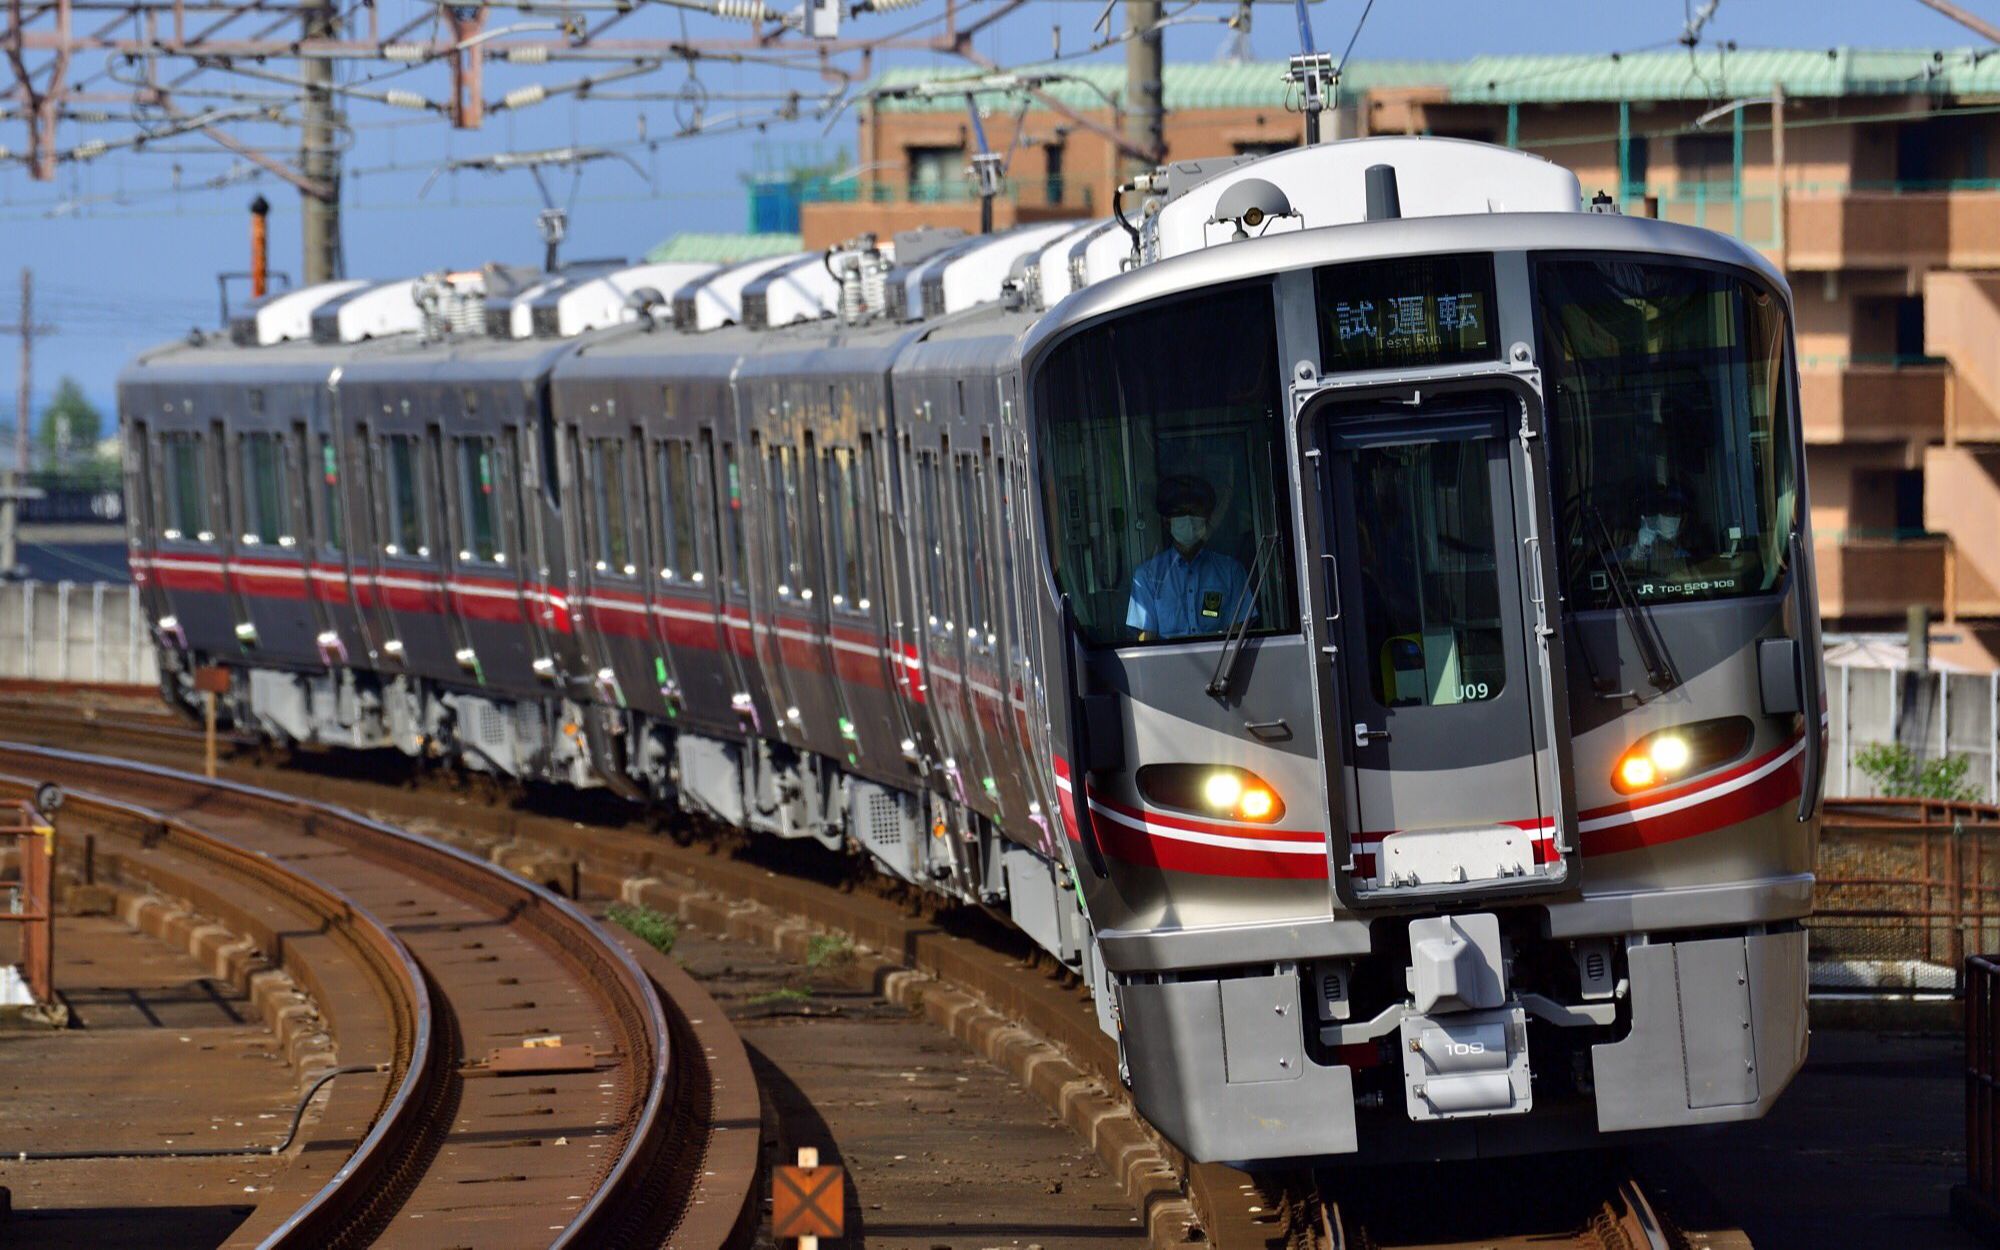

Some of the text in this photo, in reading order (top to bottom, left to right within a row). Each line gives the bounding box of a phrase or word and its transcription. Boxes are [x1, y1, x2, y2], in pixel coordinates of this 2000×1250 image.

[1337, 293, 1478, 340] 試運転
[1377, 334, 1442, 349] Test Run
[1637, 584, 1654, 595] JR
[1445, 1042, 1484, 1055] 109
